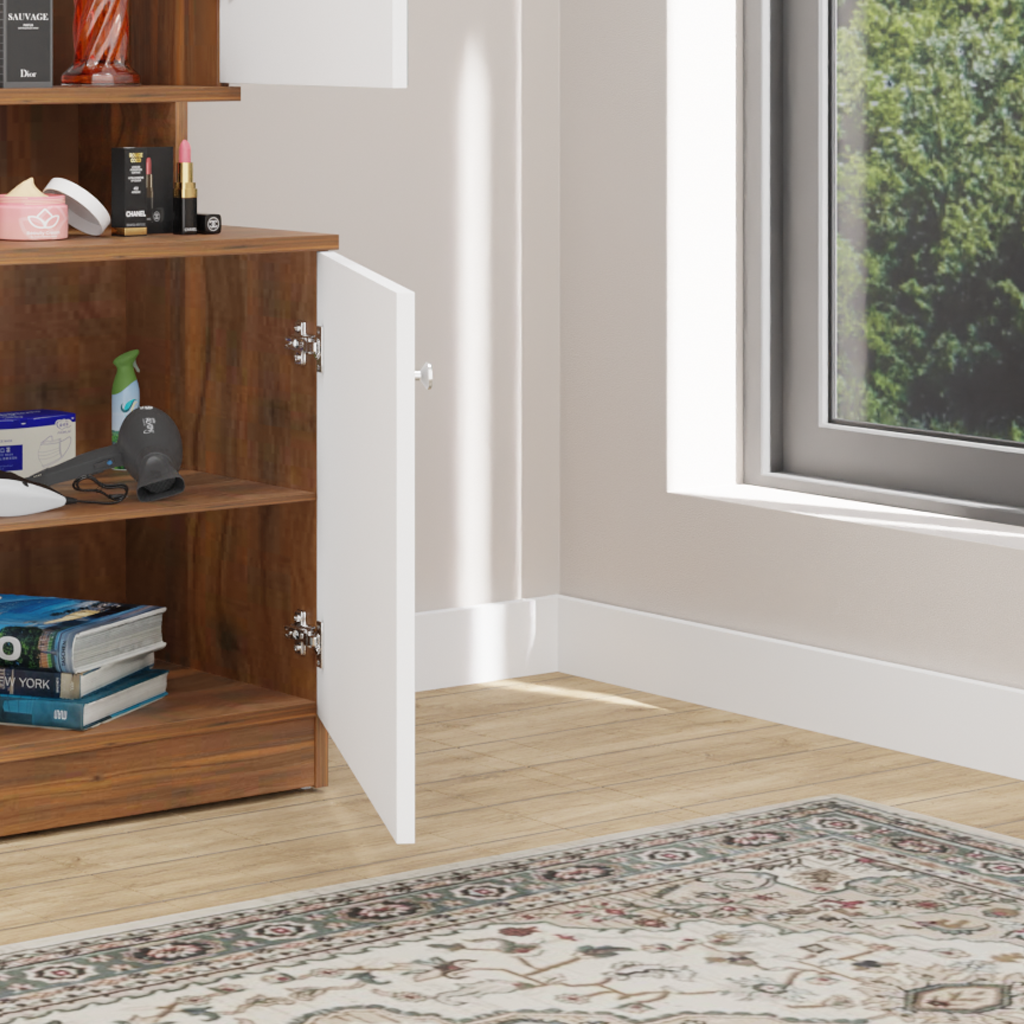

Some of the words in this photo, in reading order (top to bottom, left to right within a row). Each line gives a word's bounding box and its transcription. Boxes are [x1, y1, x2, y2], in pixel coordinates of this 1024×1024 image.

[8, 13, 49, 21] SAUVAGE
[20, 69, 37, 78] Dior
[18, 677, 50, 690] YORK
